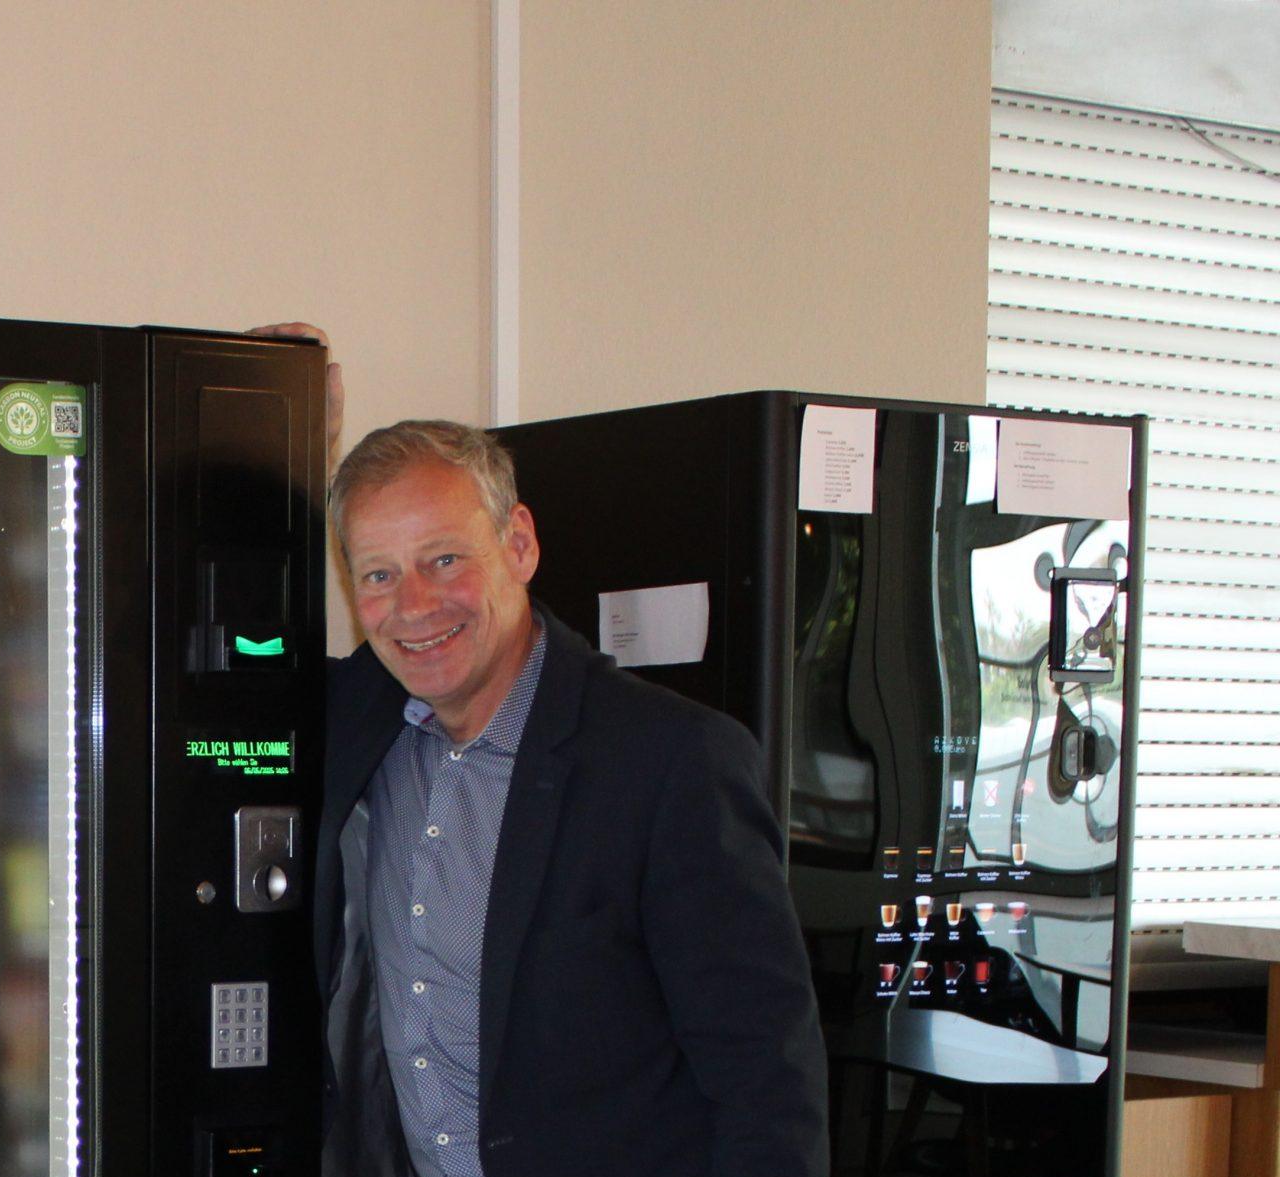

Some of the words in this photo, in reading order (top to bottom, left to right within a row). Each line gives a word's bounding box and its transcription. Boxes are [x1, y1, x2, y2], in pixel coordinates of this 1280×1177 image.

[0, 391, 20, 415] CARBON
[21, 391, 46, 417] NEUTRAL
[8, 435, 37, 447] PROJECT
